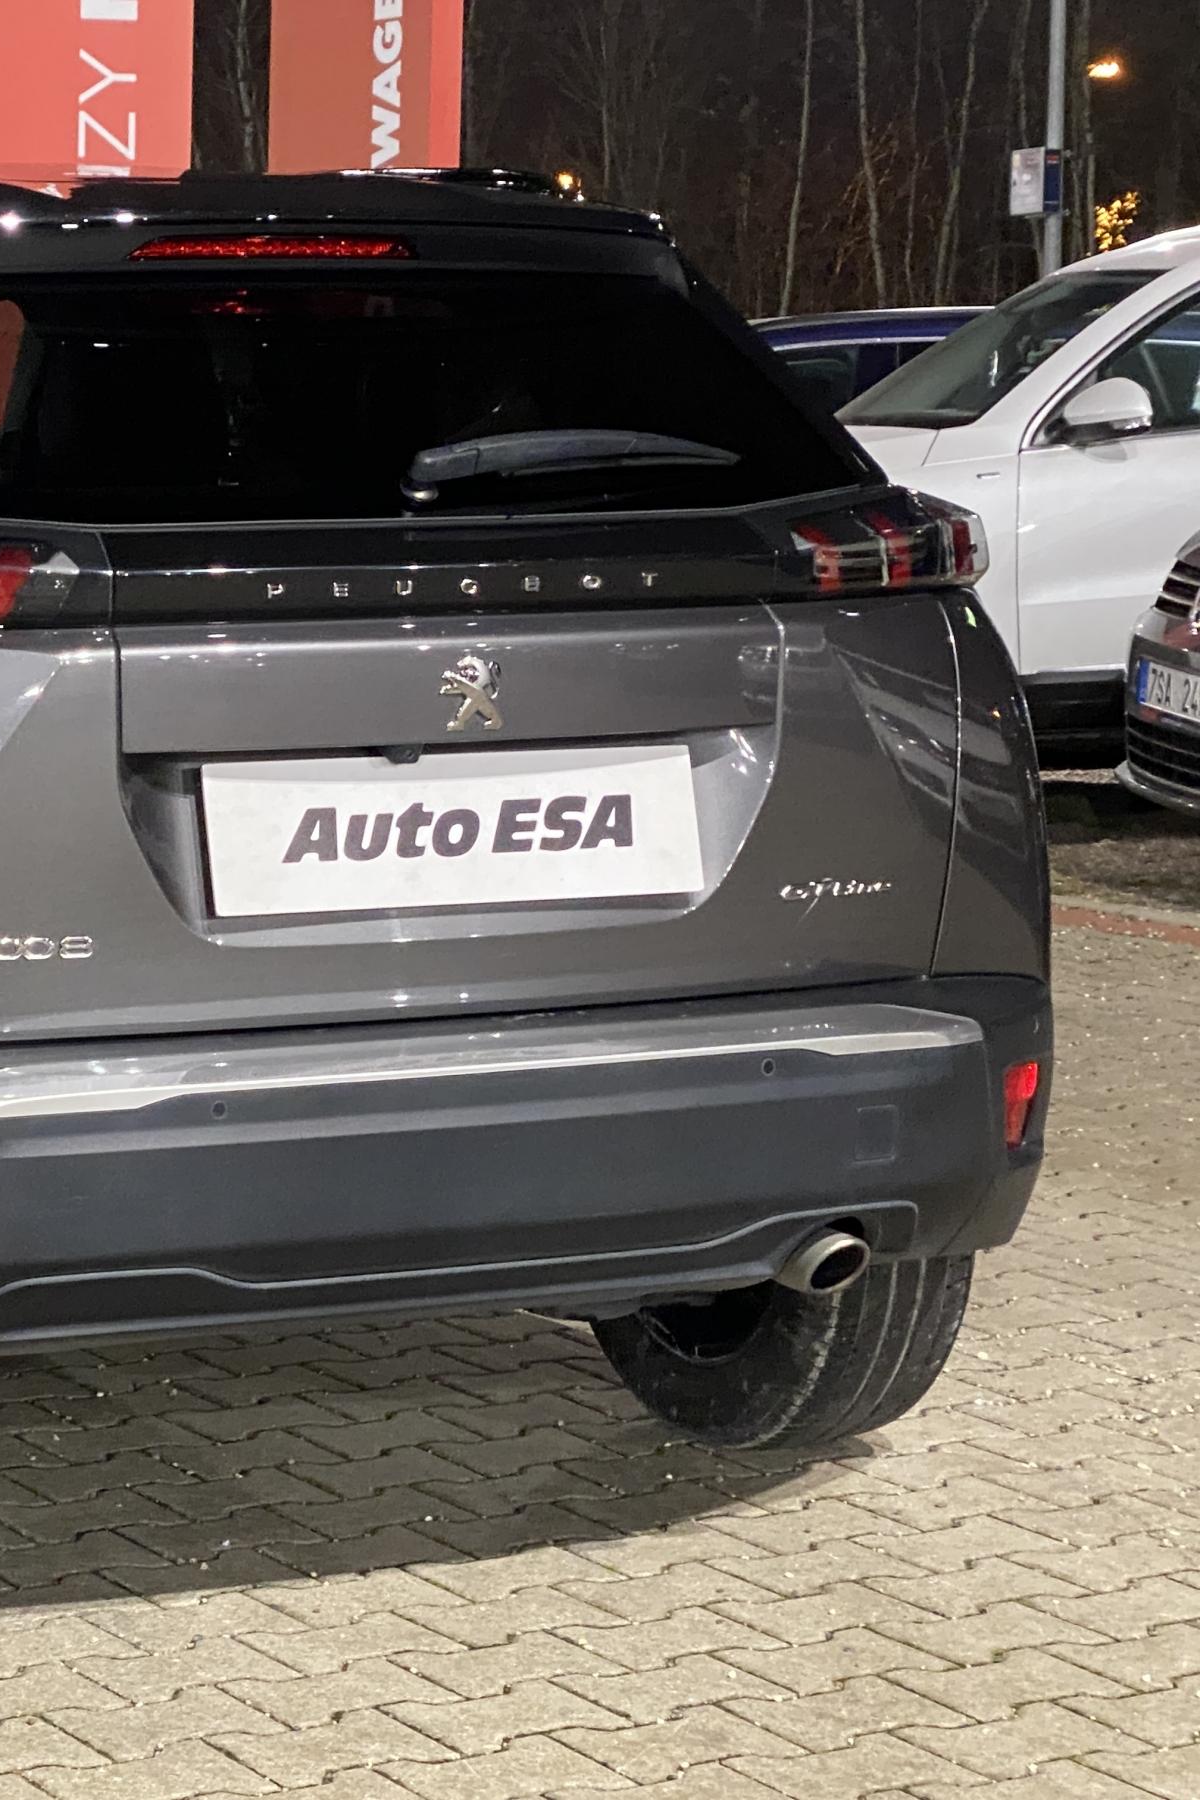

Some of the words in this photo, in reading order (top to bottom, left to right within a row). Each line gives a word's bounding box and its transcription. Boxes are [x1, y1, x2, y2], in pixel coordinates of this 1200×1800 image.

[78, 48, 138, 177] ZY
[266, 571, 659, 598] PEUGEOT
[282, 802, 480, 863] Auto
[491, 794, 634, 853] ESA
